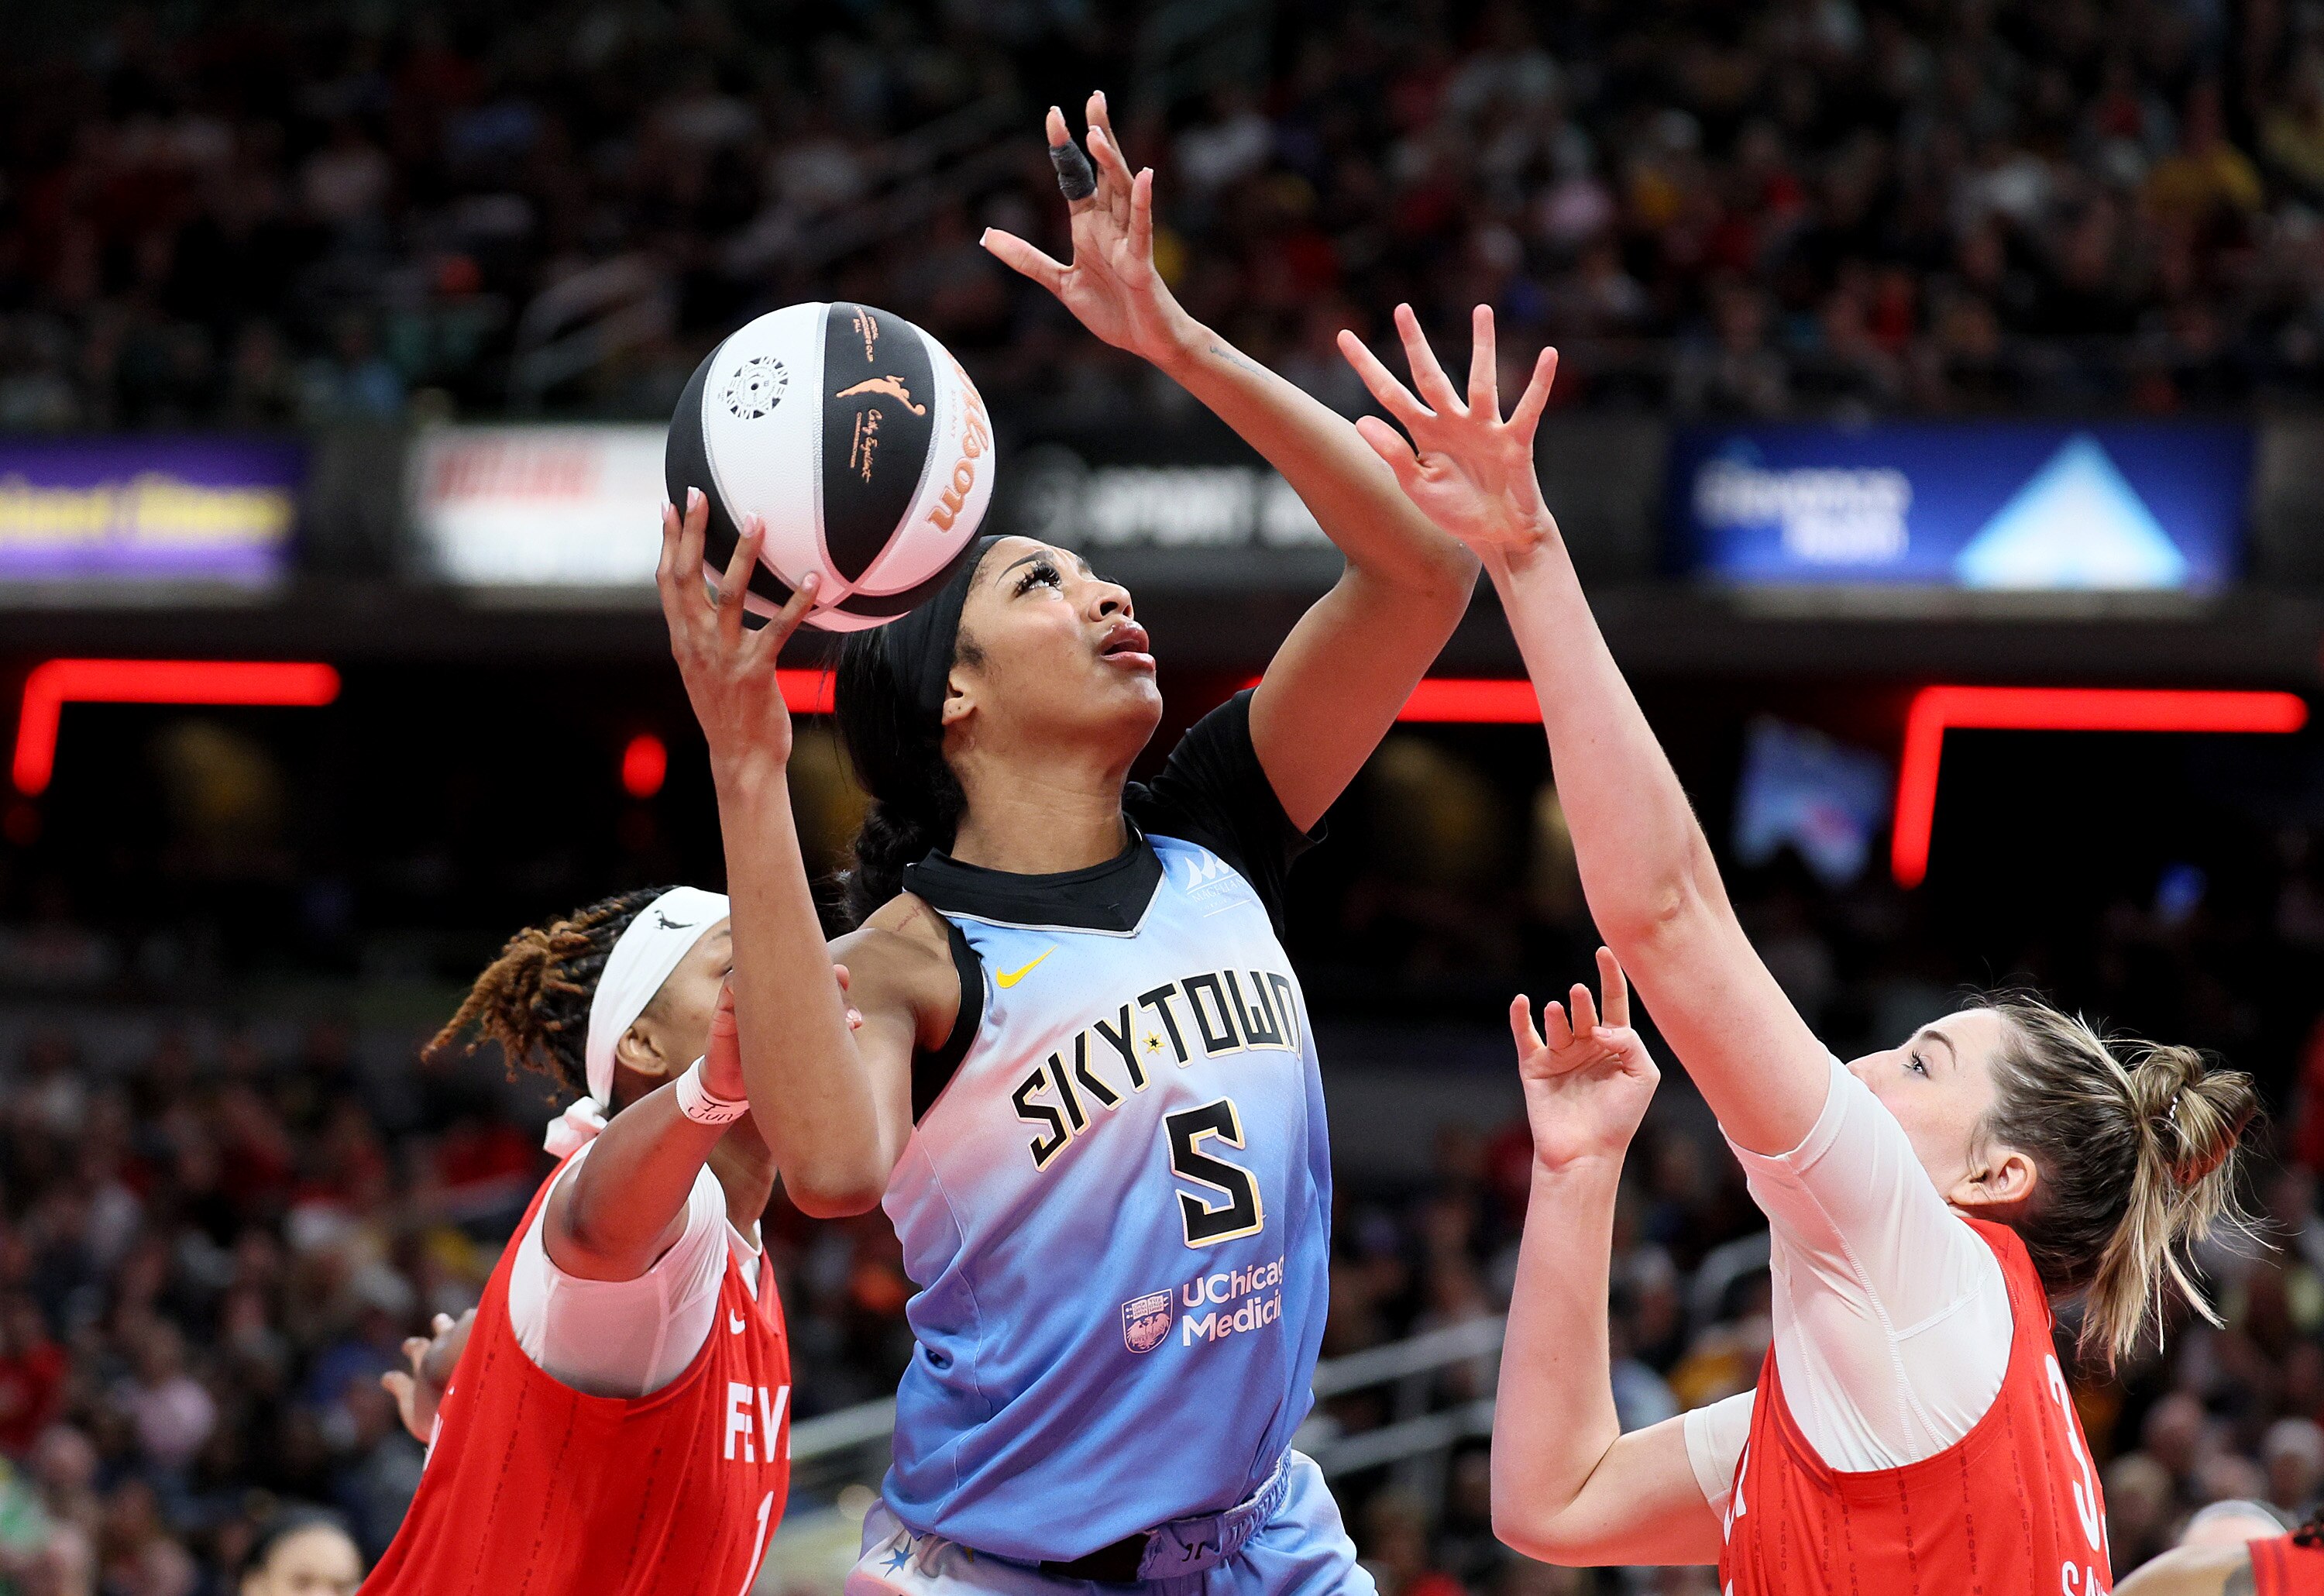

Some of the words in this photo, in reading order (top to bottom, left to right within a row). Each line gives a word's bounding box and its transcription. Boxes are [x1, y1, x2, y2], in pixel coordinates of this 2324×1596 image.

[865, 345, 875, 363] CUP
[1162, 1096, 1266, 1249] 5
[1182, 1254, 1284, 1307] UChicag
[1182, 1288, 1281, 1347] Medici
[2046, 1353, 2113, 1577] 3
